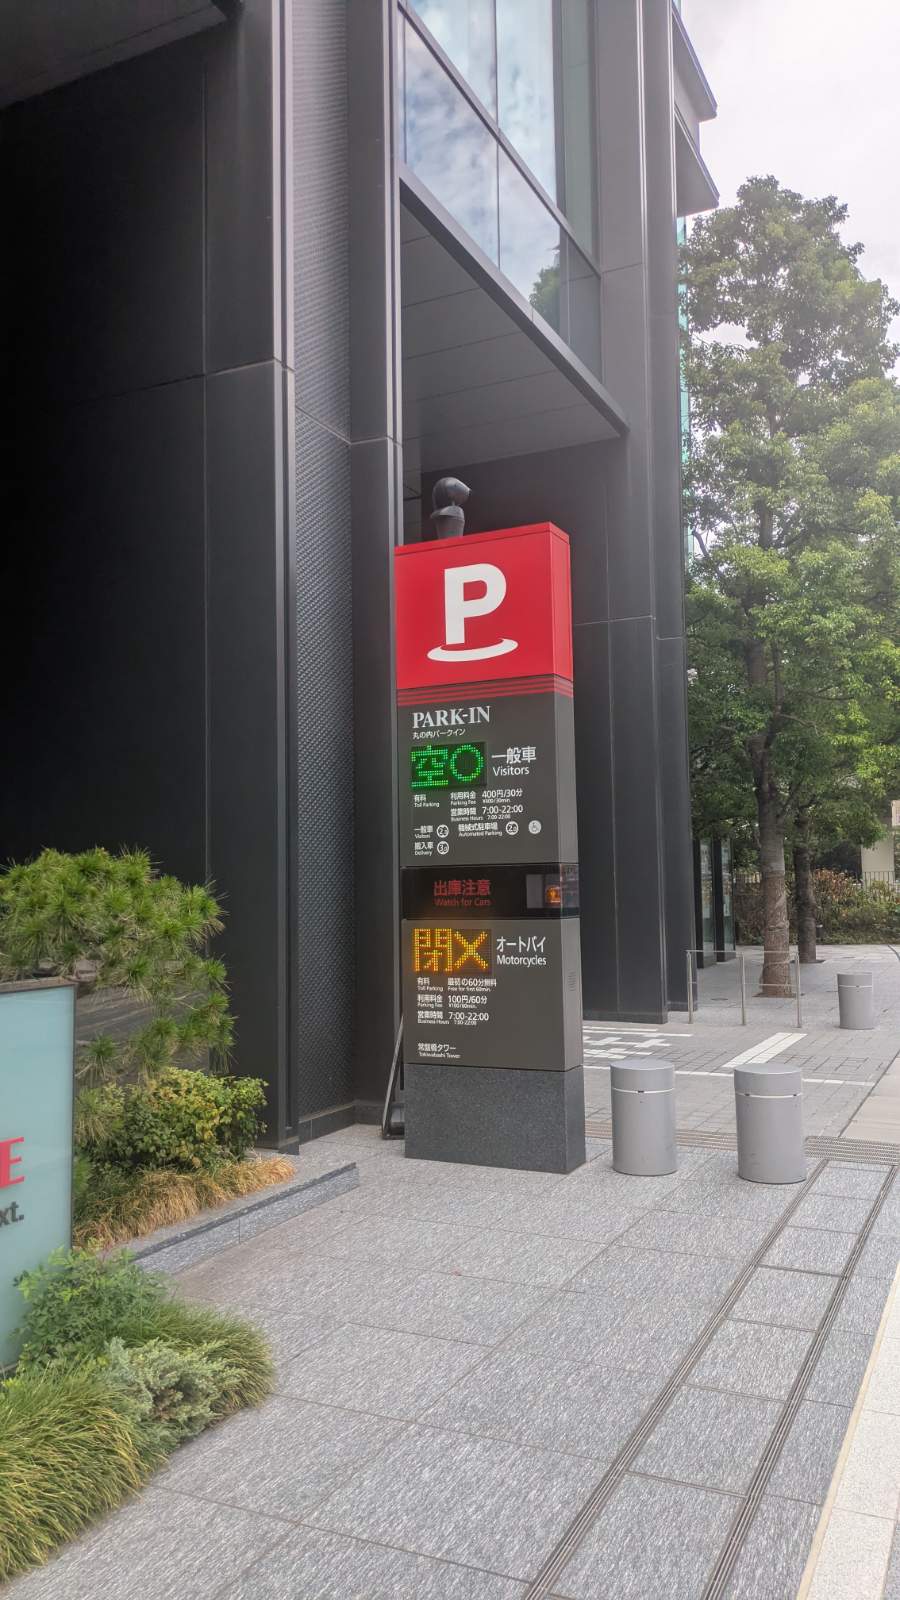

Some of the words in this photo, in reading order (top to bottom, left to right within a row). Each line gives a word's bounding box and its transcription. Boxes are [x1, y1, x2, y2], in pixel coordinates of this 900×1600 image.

[444, 563, 507, 645] P
[412, 705, 491, 729] PARK-IN
[412, 728, 466, 740] 丸の内パークイン
[491, 746, 537, 764] 一般車
[492, 765, 530, 777] Visitors
[450, 790, 477, 800] 利用料金
[481, 788, 523, 799] 400円/30分
[482, 805, 523, 815] 7:00-22:00
[433, 879, 491, 897] 出庫注意
[461, 898, 472, 906] for
[496, 935, 547, 953] オートバイ
[496, 954, 547, 967] Motorcycles
[447, 977, 497, 987] 最初の60分無料
[448, 994, 487, 1004] 100円/60分
[448, 1011, 489, 1021] 7:00-22:00
